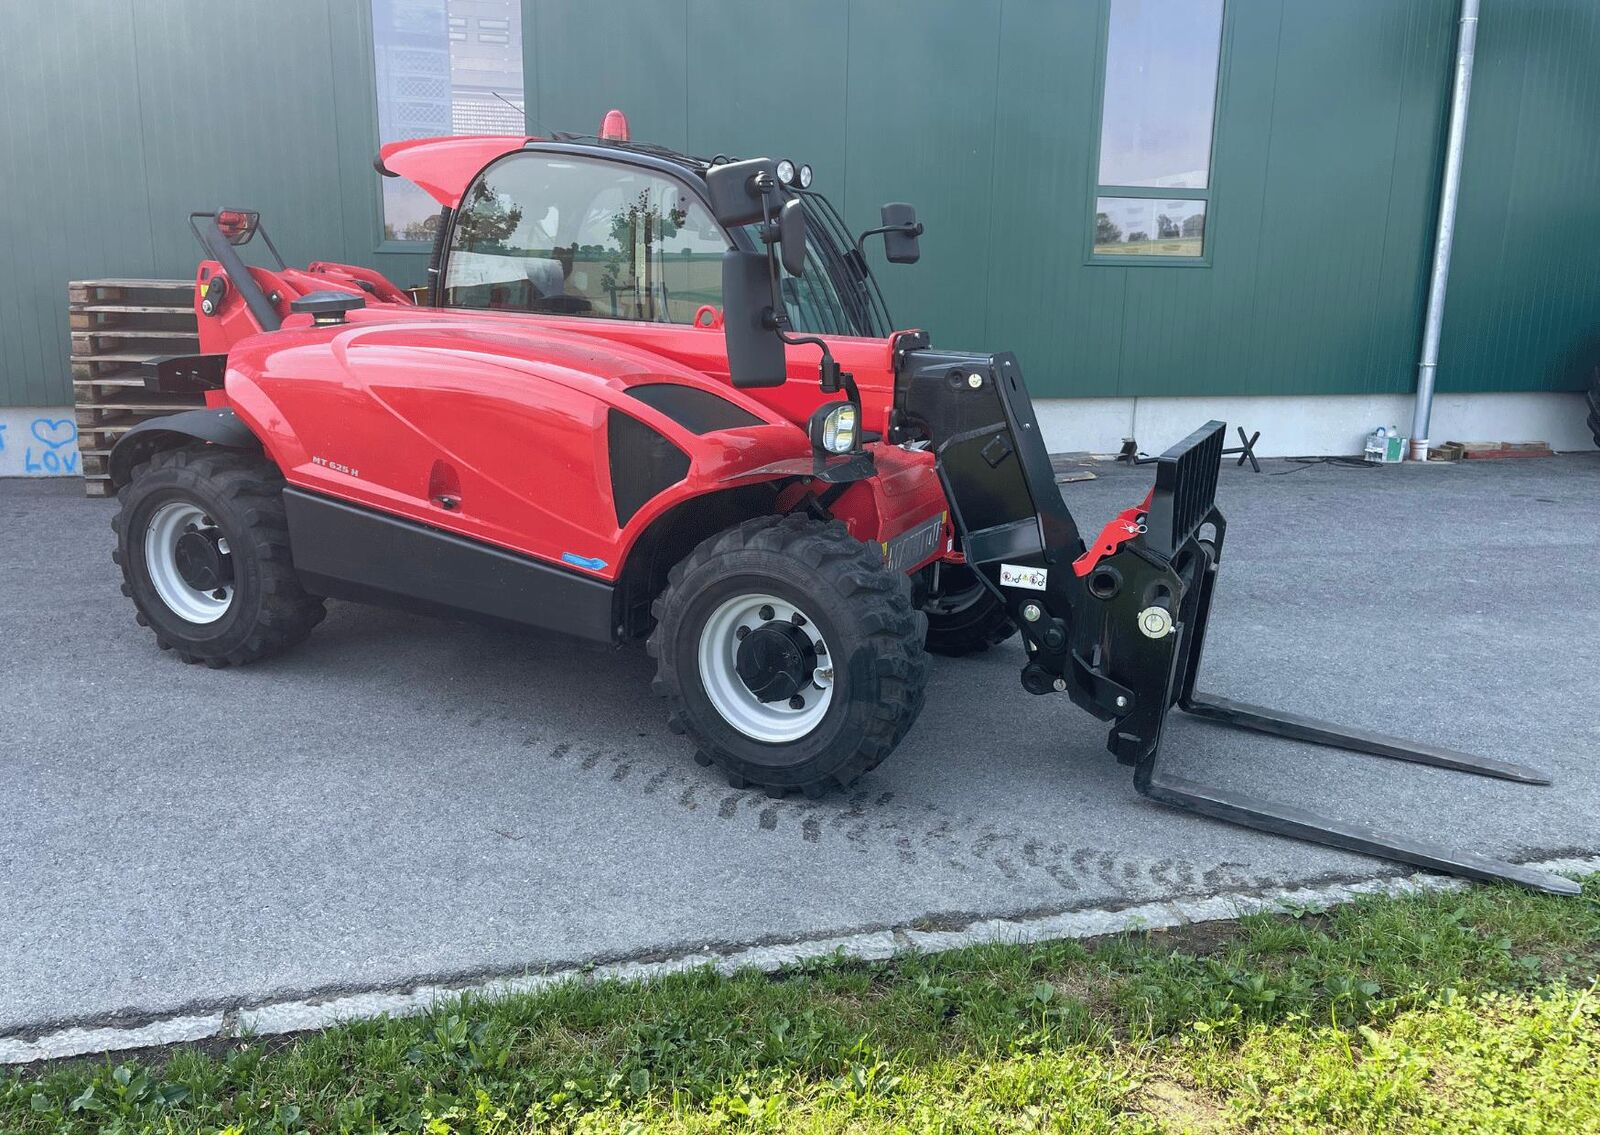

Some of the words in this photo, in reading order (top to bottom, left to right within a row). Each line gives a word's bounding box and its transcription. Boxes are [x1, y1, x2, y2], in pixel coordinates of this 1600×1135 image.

[25, 447, 78, 474] LOV
[312, 455, 328, 466] MT
[329, 461, 349, 474] 625
[351, 468, 359, 477] H
